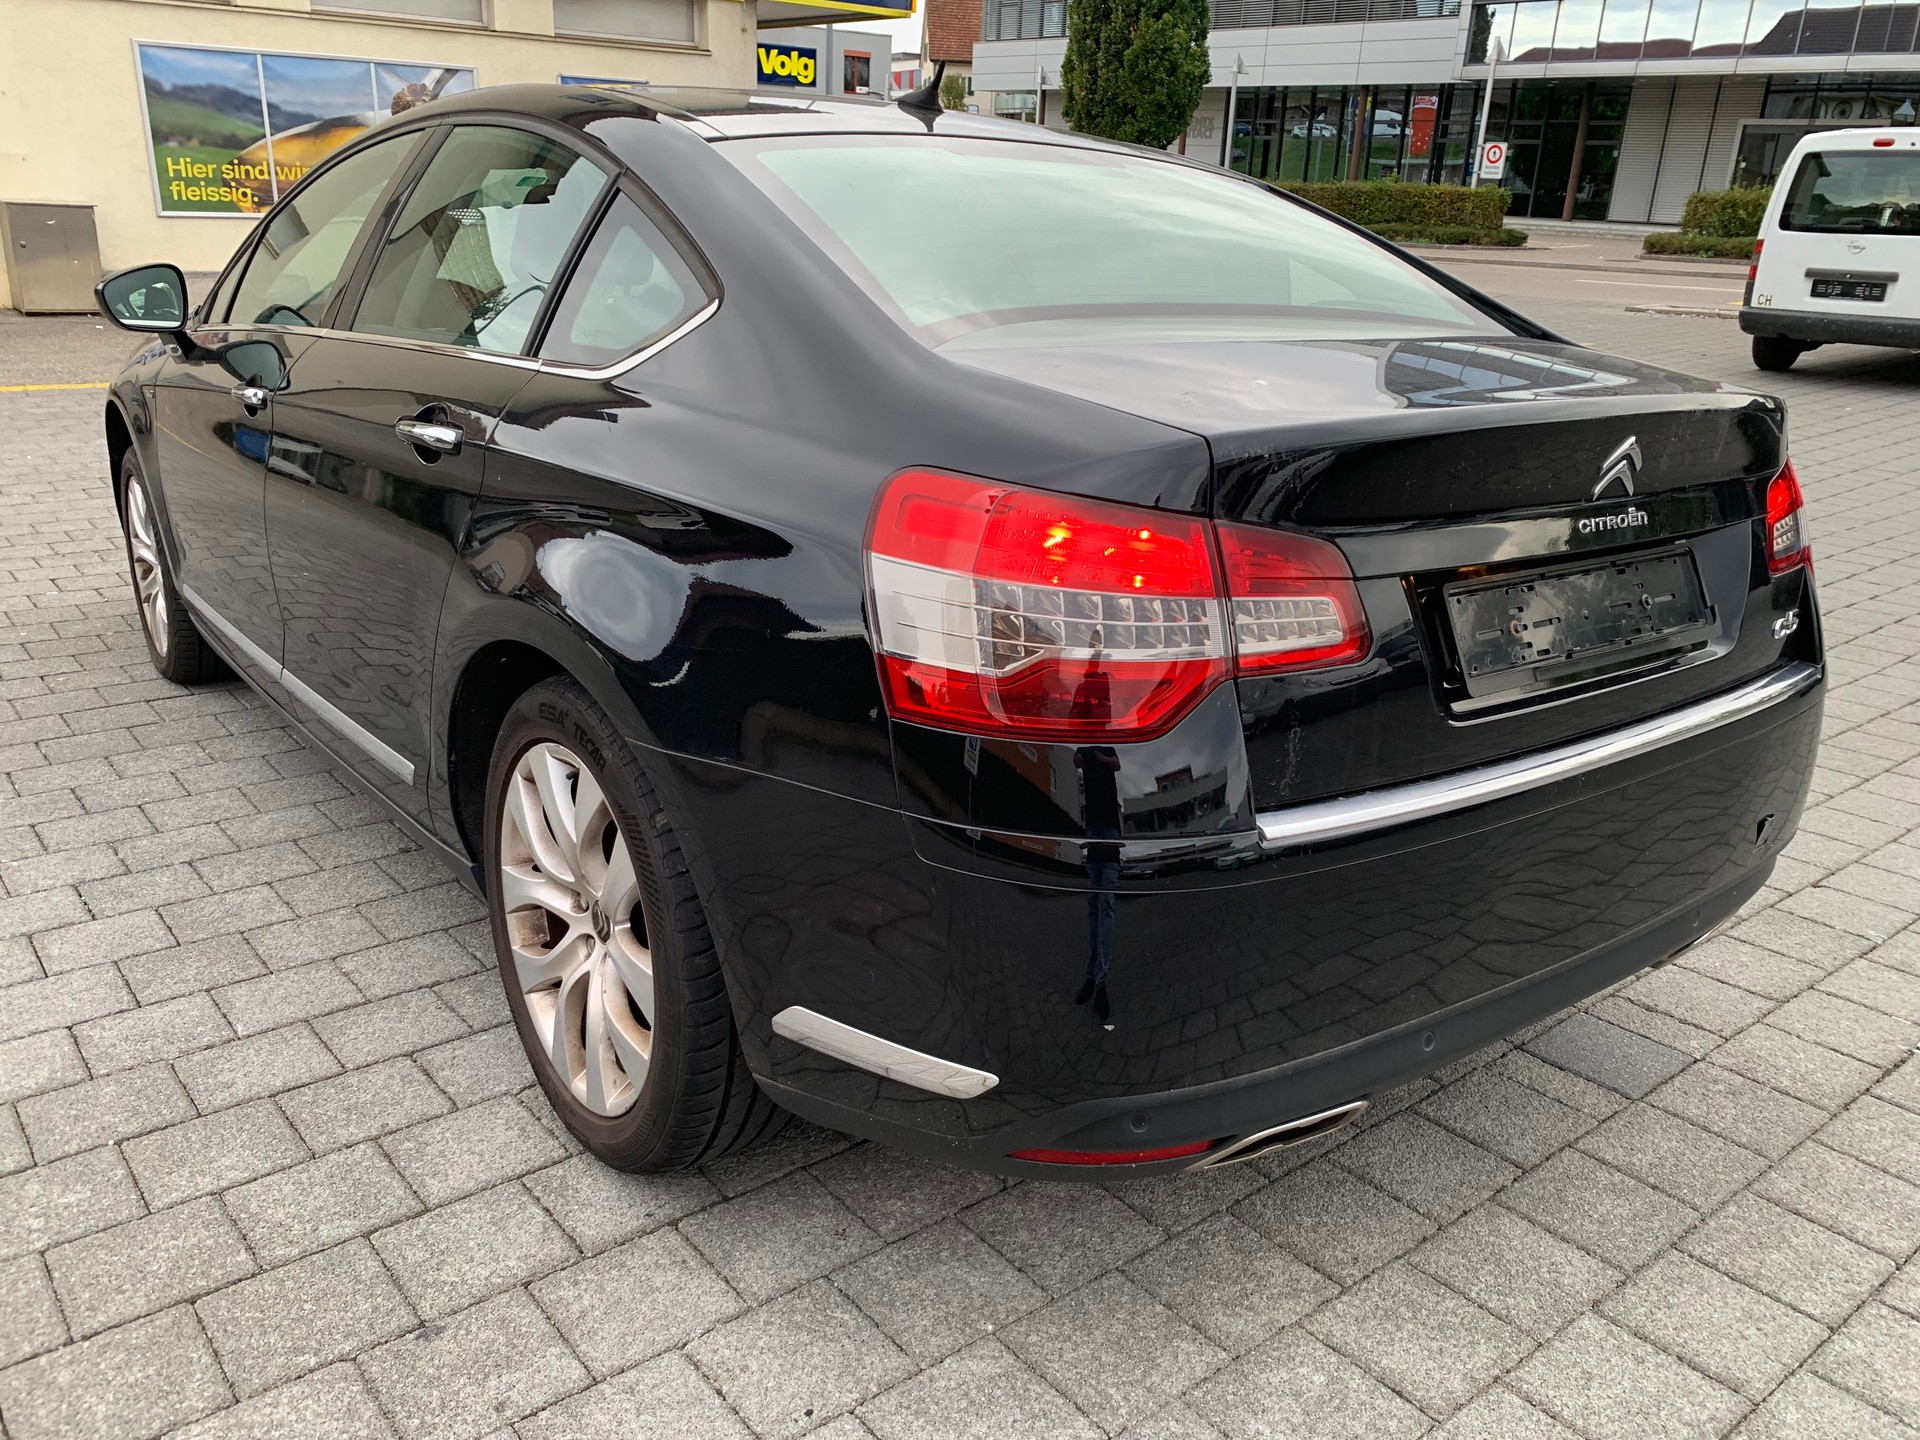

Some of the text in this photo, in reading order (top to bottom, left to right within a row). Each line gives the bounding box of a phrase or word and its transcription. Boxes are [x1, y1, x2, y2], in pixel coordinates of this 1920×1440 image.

[757, 47, 815, 84] Volg
[166, 157, 217, 178] Hier
[221, 159, 268, 180] sind
[169, 180, 259, 206] fleissig.
[1757, 293, 1773, 306] CH
[574, 720, 607, 775] TECAR
